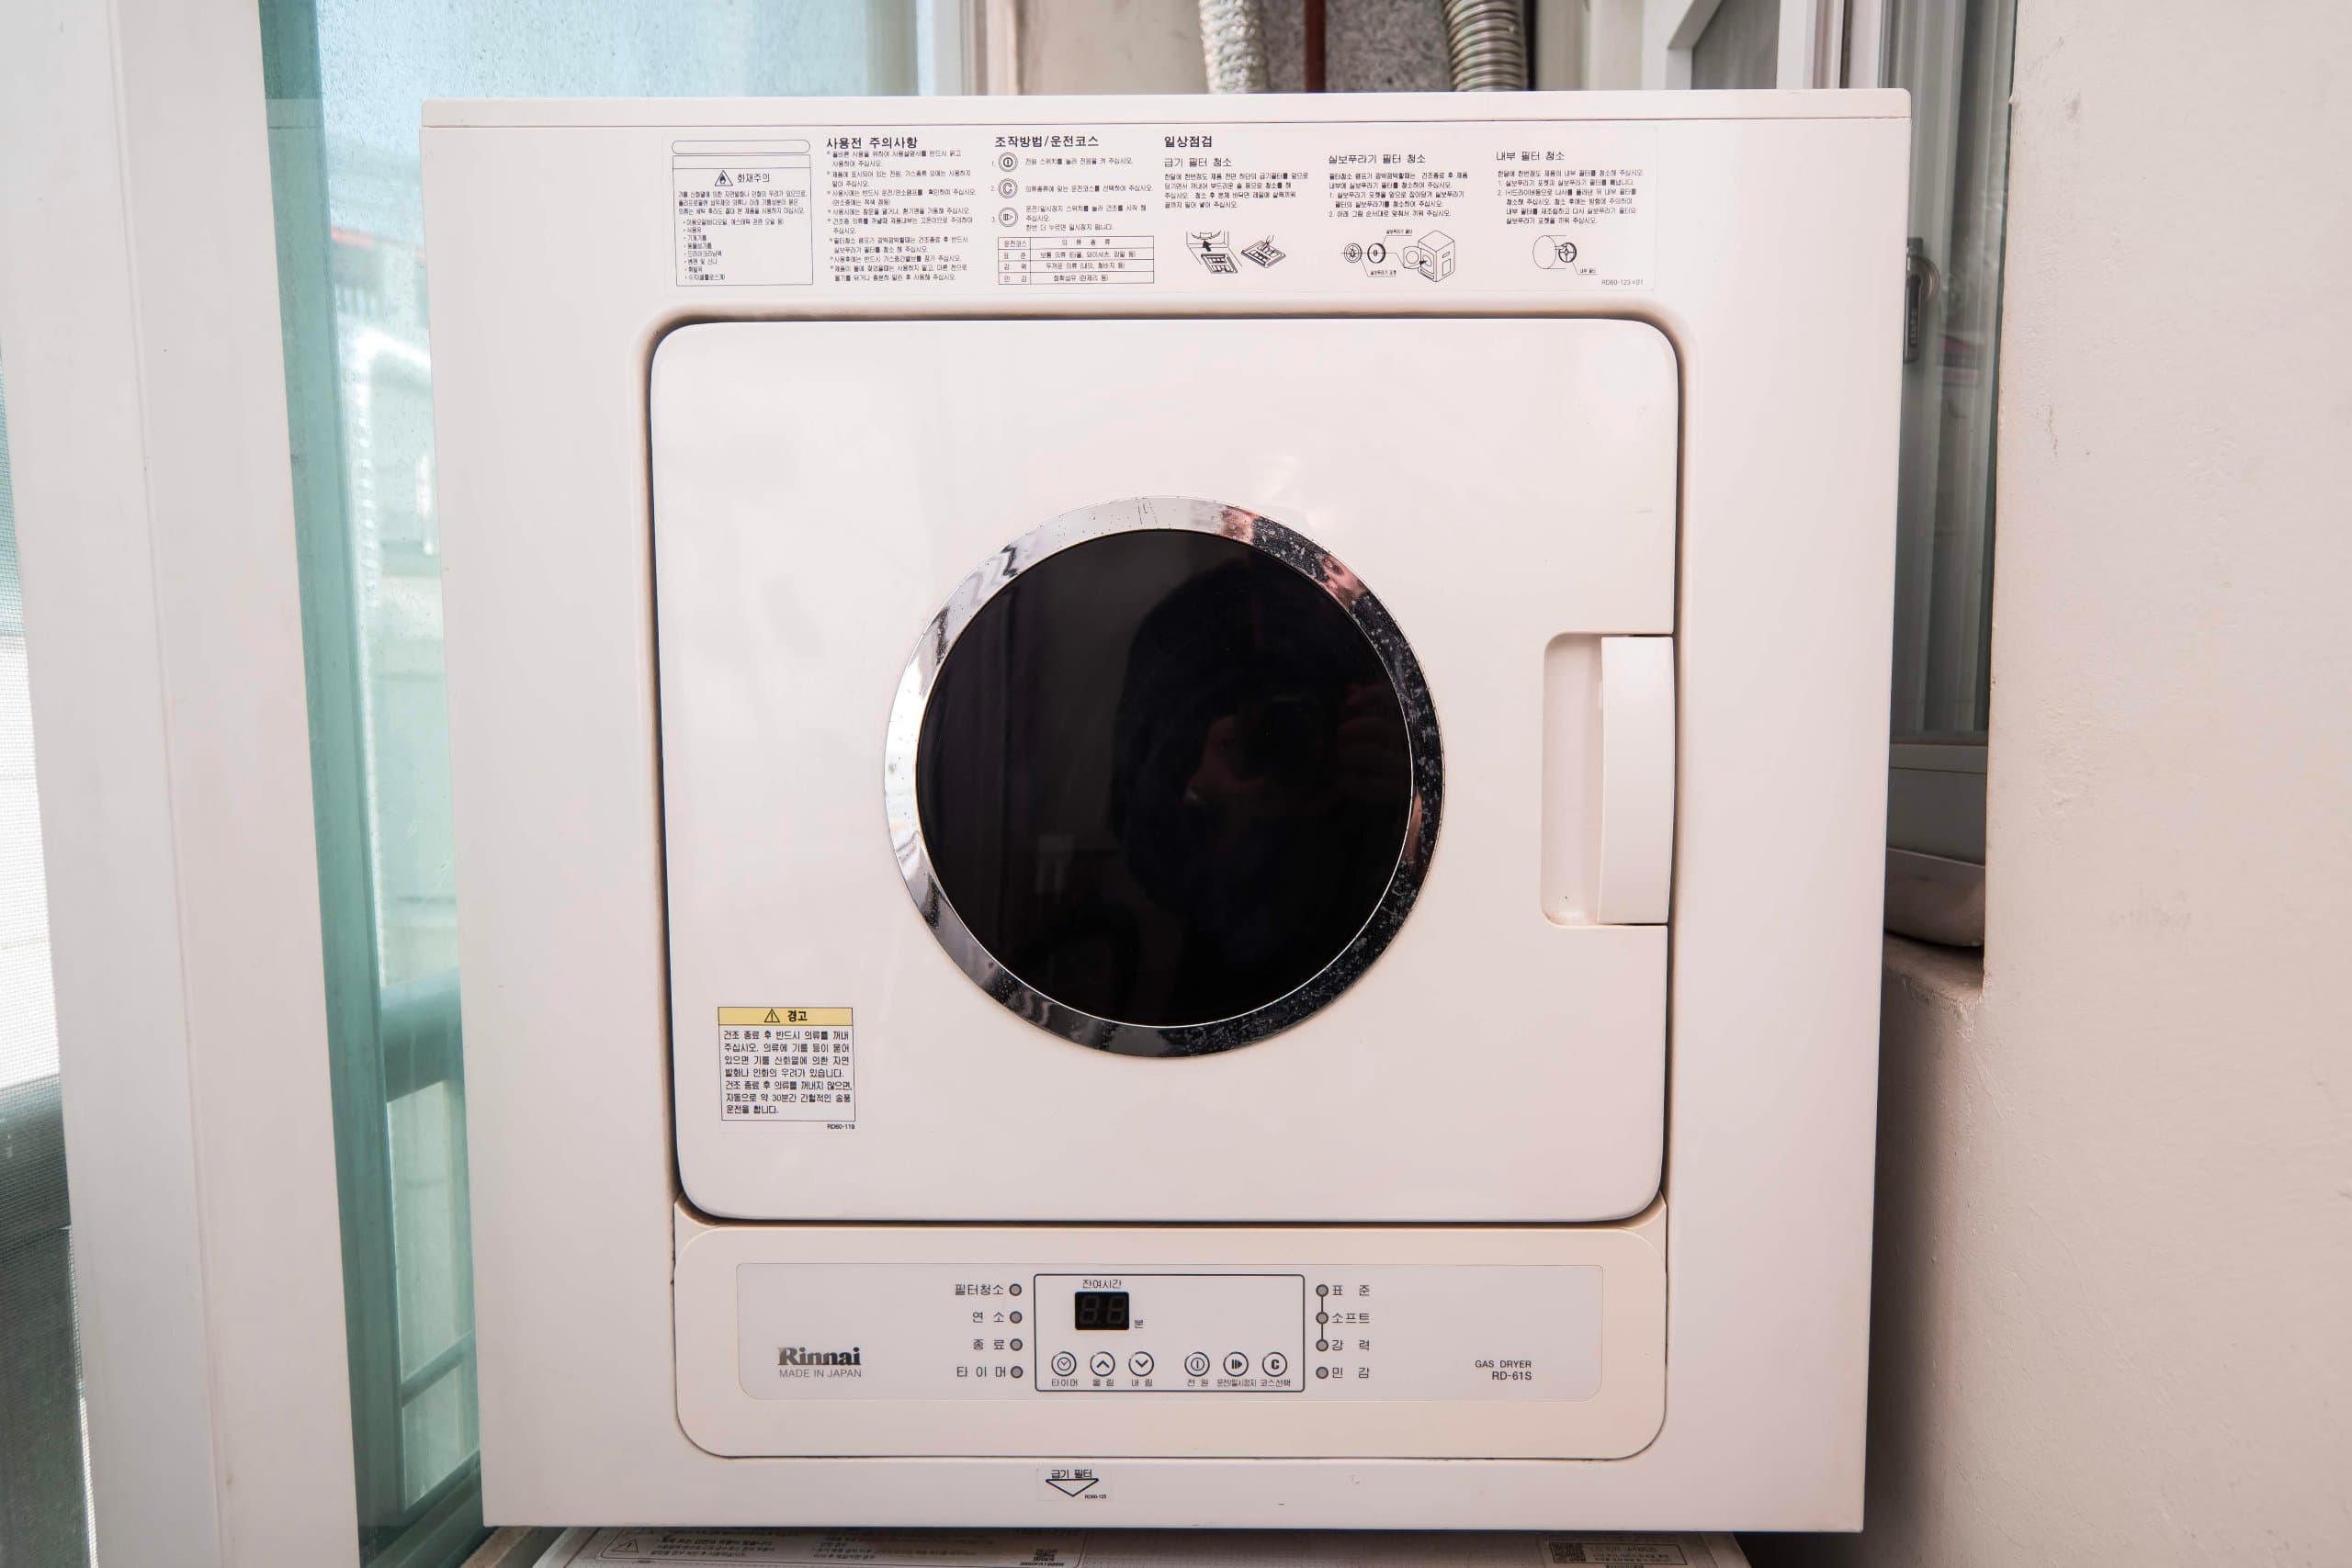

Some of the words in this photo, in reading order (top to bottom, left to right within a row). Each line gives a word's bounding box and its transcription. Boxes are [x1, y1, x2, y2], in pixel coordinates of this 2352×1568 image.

[827, 137, 862, 150] 사용전
[869, 137, 918, 149] 주의사항
[995, 135, 1099, 148] 조작방법/운전코스
[1164, 135, 1212, 148] 일상점검
[1329, 154, 1377, 164] 실보푸라기
[1383, 153, 1401, 164] 필터
[1407, 153, 1426, 164] 청소
[1496, 152, 1516, 161] 내부
[1521, 151, 1540, 162] 필터
[1545, 151, 1565, 161] 청소
[1164, 158, 1183, 168] 급기
[1189, 157, 1207, 168] 필터
[1213, 157, 1232, 167] 청소
[737, 173, 770, 183] 화재주의
[787, 1010, 808, 1022] 경고
[724, 1030, 740, 1040] 건조
[743, 1030, 760, 1040] 종료
[764, 1030, 772, 1040] 후
[775, 1031, 800, 1041] 반드시
[804, 1031, 829, 1041] 의류를
[832, 1031, 849, 1041] 꺼내
[724, 1043, 759, 1053] 주십시오.
[763, 1043, 788, 1053] 의류에
[792, 1043, 808, 1053] 기름
[812, 1043, 829, 1053] 등이
[833, 1043, 850, 1054] 묻어
[724, 1055, 749, 1066] 있으면
[753, 1055, 770, 1066] 기름
[775, 1055, 808, 1066] 산화열에
[812, 1055, 829, 1066] 의한
[832, 1055, 849, 1066] 자연
[725, 1067, 750, 1077] 발화나
[752, 1068, 777, 1077] 인화의
[781, 1068, 806, 1077] 우려가
[809, 1068, 844, 1078] 있습니다.
[726, 1080, 741, 1090] 건조
[744, 1080, 760, 1090] 종료
[763, 1080, 771, 1090] 후
[775, 1080, 797, 1090] 의류를
[801, 1081, 824, 1090] 꺼내지
[827, 1081, 853, 1091] 않으면,
[726, 1093, 757, 1102] 자동으로
[760, 1093, 769, 1102] 약
[772, 1093, 797, 1103] 30분간
[835, 1093, 851, 1103] 송풍
[727, 1104, 750, 1114] 운전을
[753, 1105, 779, 1114] 합니다.
[1082, 1279, 1122, 1289] 잔여시간
[955, 1284, 1004, 1296] 필터청소
[1332, 1313, 1370, 1324] 소프트
[777, 1347, 861, 1366] Rinnai
[1475, 1359, 1495, 1369] GAS
[1499, 1359, 1532, 1369] DRYER
[779, 1369, 810, 1378] MADE
[813, 1369, 824, 1378] IN
[827, 1369, 862, 1378] JAPAN
[1491, 1371, 1532, 1381] RD-61S
[1051, 1378, 1079, 1387] 타이머
[1260, 1379, 1291, 1388] 코스선택
[1051, 1469, 1069, 1480] 급기
[1074, 1469, 1093, 1479] 필터
